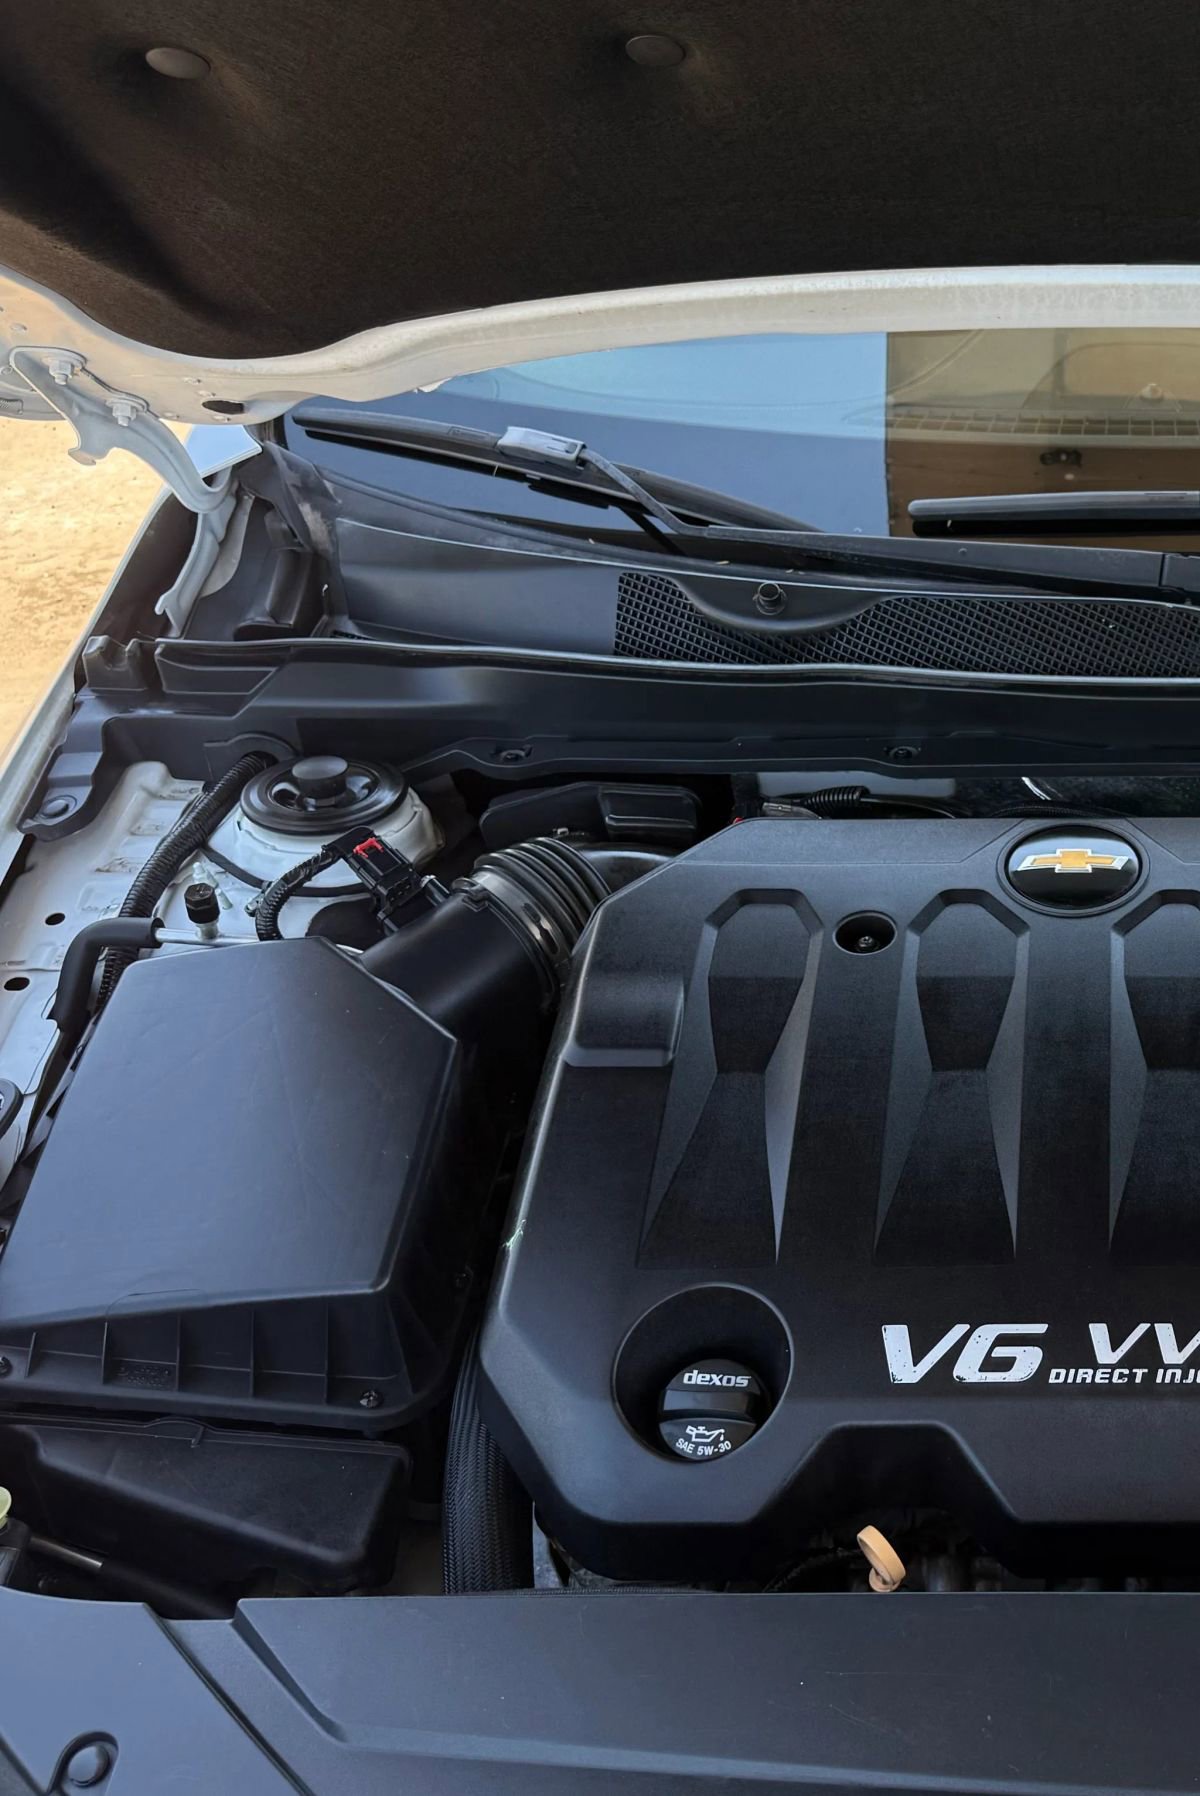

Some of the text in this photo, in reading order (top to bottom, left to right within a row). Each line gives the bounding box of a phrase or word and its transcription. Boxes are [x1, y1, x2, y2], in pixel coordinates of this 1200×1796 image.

[881, 1323, 1049, 1384] V6
[683, 1369, 752, 1388] dexos
[1048, 1368, 1148, 1385] DIRECT
[675, 1437, 732, 1456] SAE 5W-30
